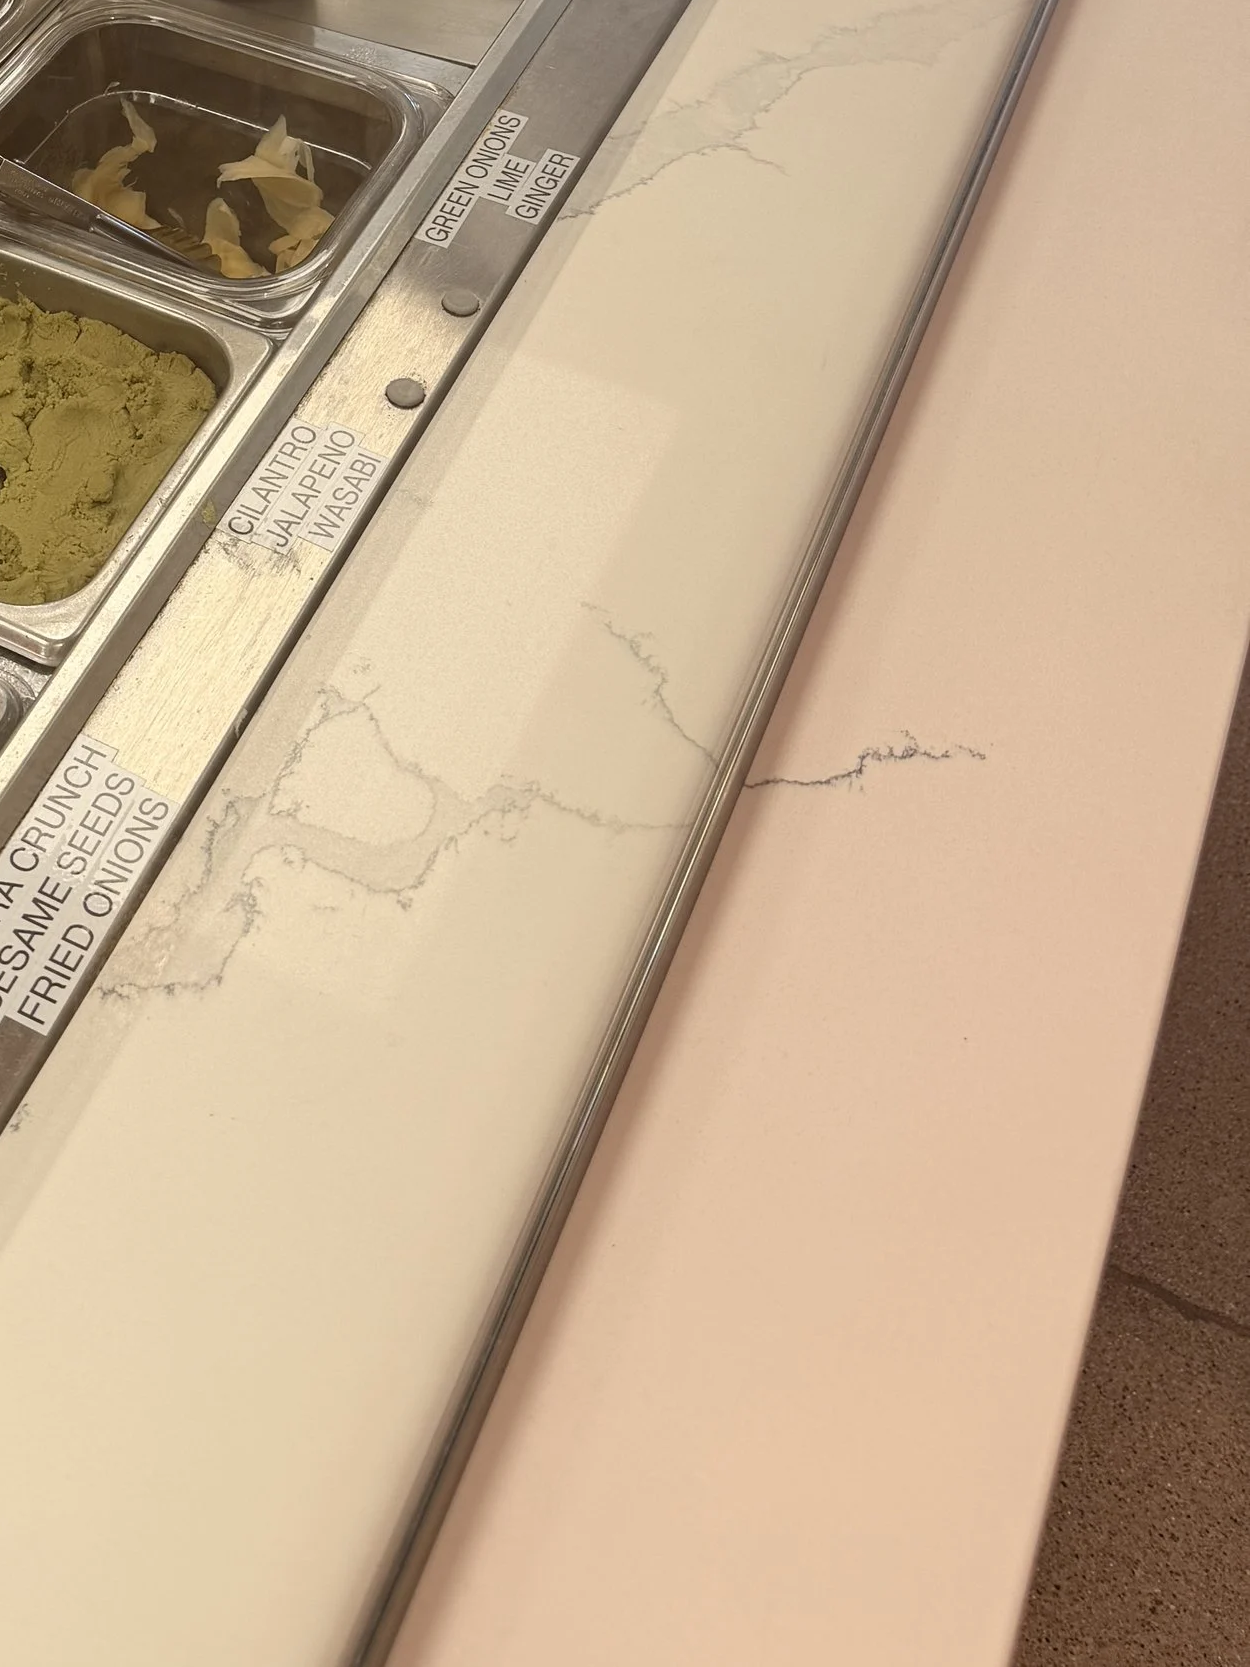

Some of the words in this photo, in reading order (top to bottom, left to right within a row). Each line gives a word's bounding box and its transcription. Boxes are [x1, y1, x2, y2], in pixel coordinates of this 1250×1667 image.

[425, 180, 480, 242] GREEN
[465, 115, 521, 179] ONIONS
[487, 159, 530, 202] LIME
[515, 153, 574, 219] GINGER
[227, 425, 317, 536] CILANTRO
[266, 430, 355, 548] JALAPENO
[308, 452, 382, 539] WASABI
[9, 743, 107, 872] CRUNCH
[56, 772, 135, 876] SEEDS
[17, 924, 95, 1026] FRIED
[83, 797, 169, 918] ONIONS
